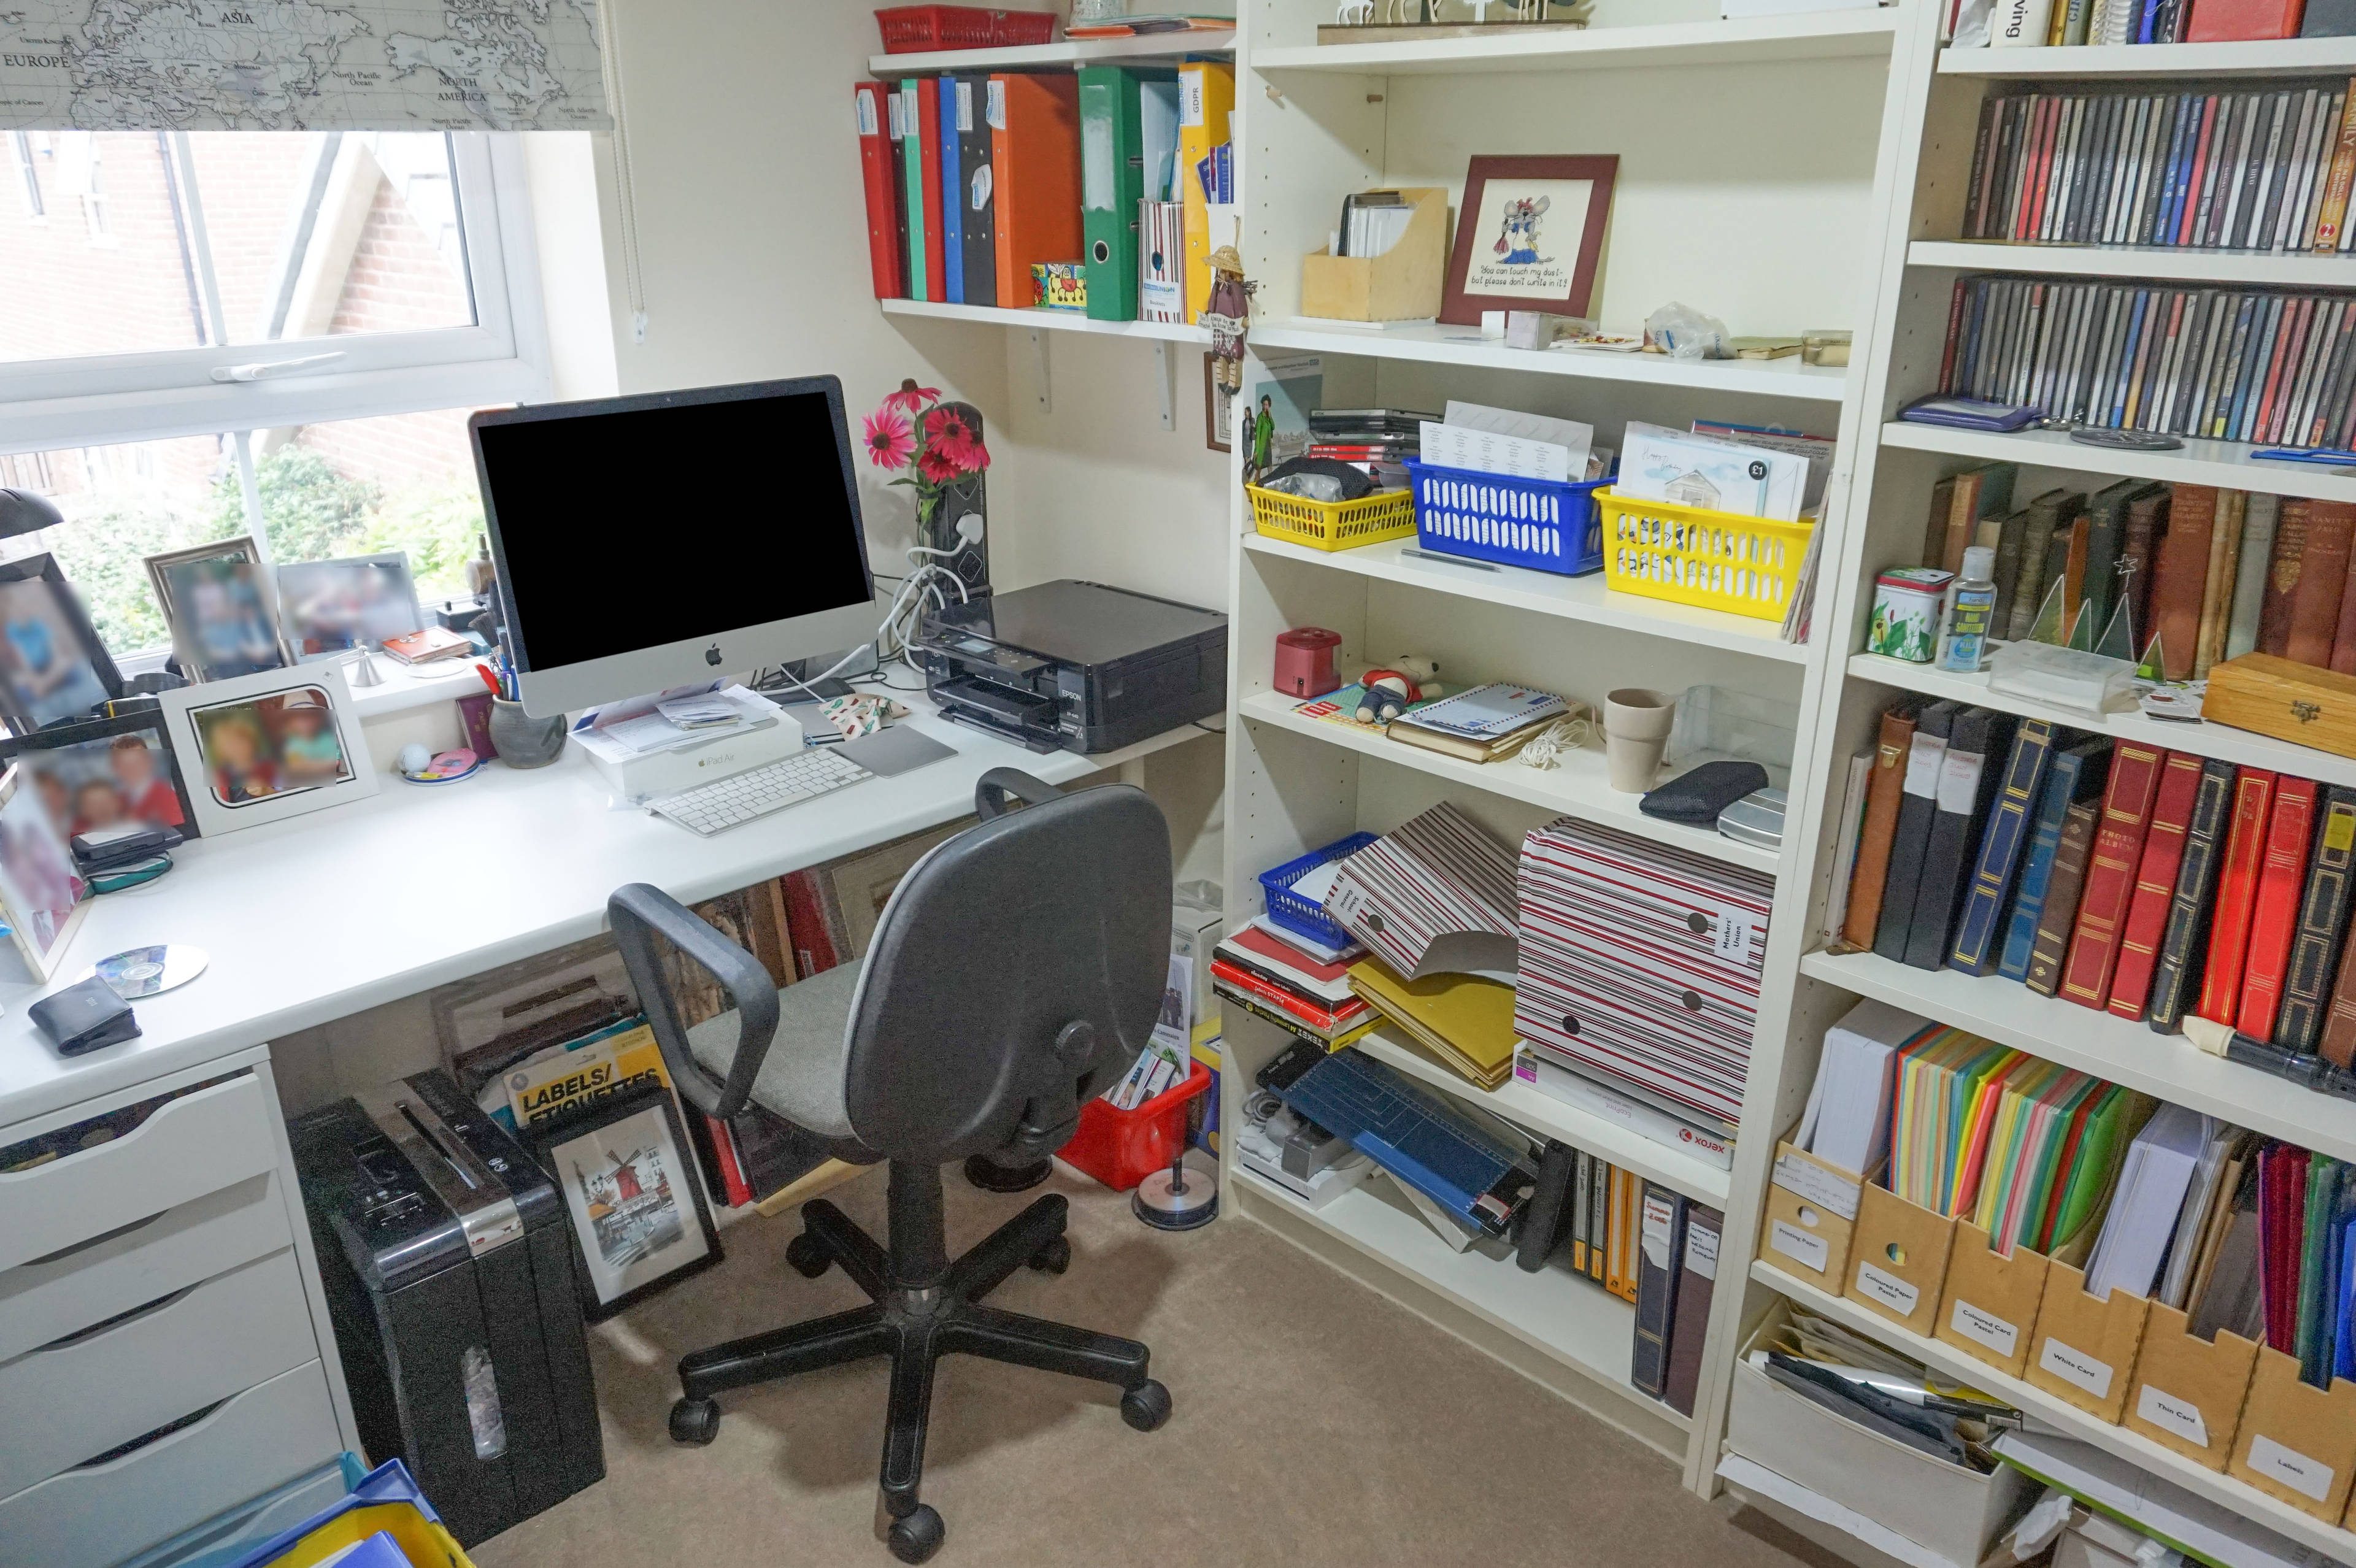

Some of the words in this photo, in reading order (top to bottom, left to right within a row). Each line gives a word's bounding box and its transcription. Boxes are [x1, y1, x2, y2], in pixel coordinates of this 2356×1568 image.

[222, 12, 254, 24] ASIA
[2, 54, 71, 68] EUROPE
[332, 70, 355, 79] North
[438, 77, 477, 87] NORTH
[437, 92, 487, 102] AMERICA
[1480, 264, 1494, 274] You
[1509, 266, 1528, 275] touch
[1530, 269, 1541, 279] my
[1471, 275, 1483, 284] but
[1485, 278, 1507, 287] please
[1509, 277, 1525, 286] don't
[1527, 278, 1546, 286] write
[1557, 279, 1568, 288] it!
[1752, 464, 1763, 475] £1
[1062, 690, 1081, 701] EPSON
[706, 757, 723, 766] iPad
[725, 754, 735, 763] Air
[2102, 829, 2135, 844] PHOTO
[2101, 838, 2133, 851] ALBUM
[1340, 890, 1353, 909] General
[1723, 918, 1731, 949] Mothers'
[1157, 1029, 1180, 1040] Campaign
[1288, 1024, 1296, 1033] A4
[523, 1063, 612, 1113] LABELS/
[1605, 1102, 1631, 1118] EcoPrint
[1695, 1136, 1725, 1154] xerox
[1690, 1224, 1711, 1237] Summer
[1779, 1227, 1801, 1242] Printing
[1801, 1237, 1819, 1250] Paper
[1865, 1272, 1893, 1291] Coloured
[1895, 1286, 1914, 1301] Paper
[1877, 1286, 1897, 1299] Pastel
[1963, 1310, 1993, 1328] Coloured
[1994, 1325, 2011, 1336] Card
[1974, 1322, 1994, 1335] Pastel
[2053, 1353, 2076, 1368] White
[2077, 1366, 2095, 1378] Card
[2157, 1402, 2174, 1414] Thin
[2176, 1412, 2195, 1424] Card
[2277, 1458, 2304, 1475] Labels
